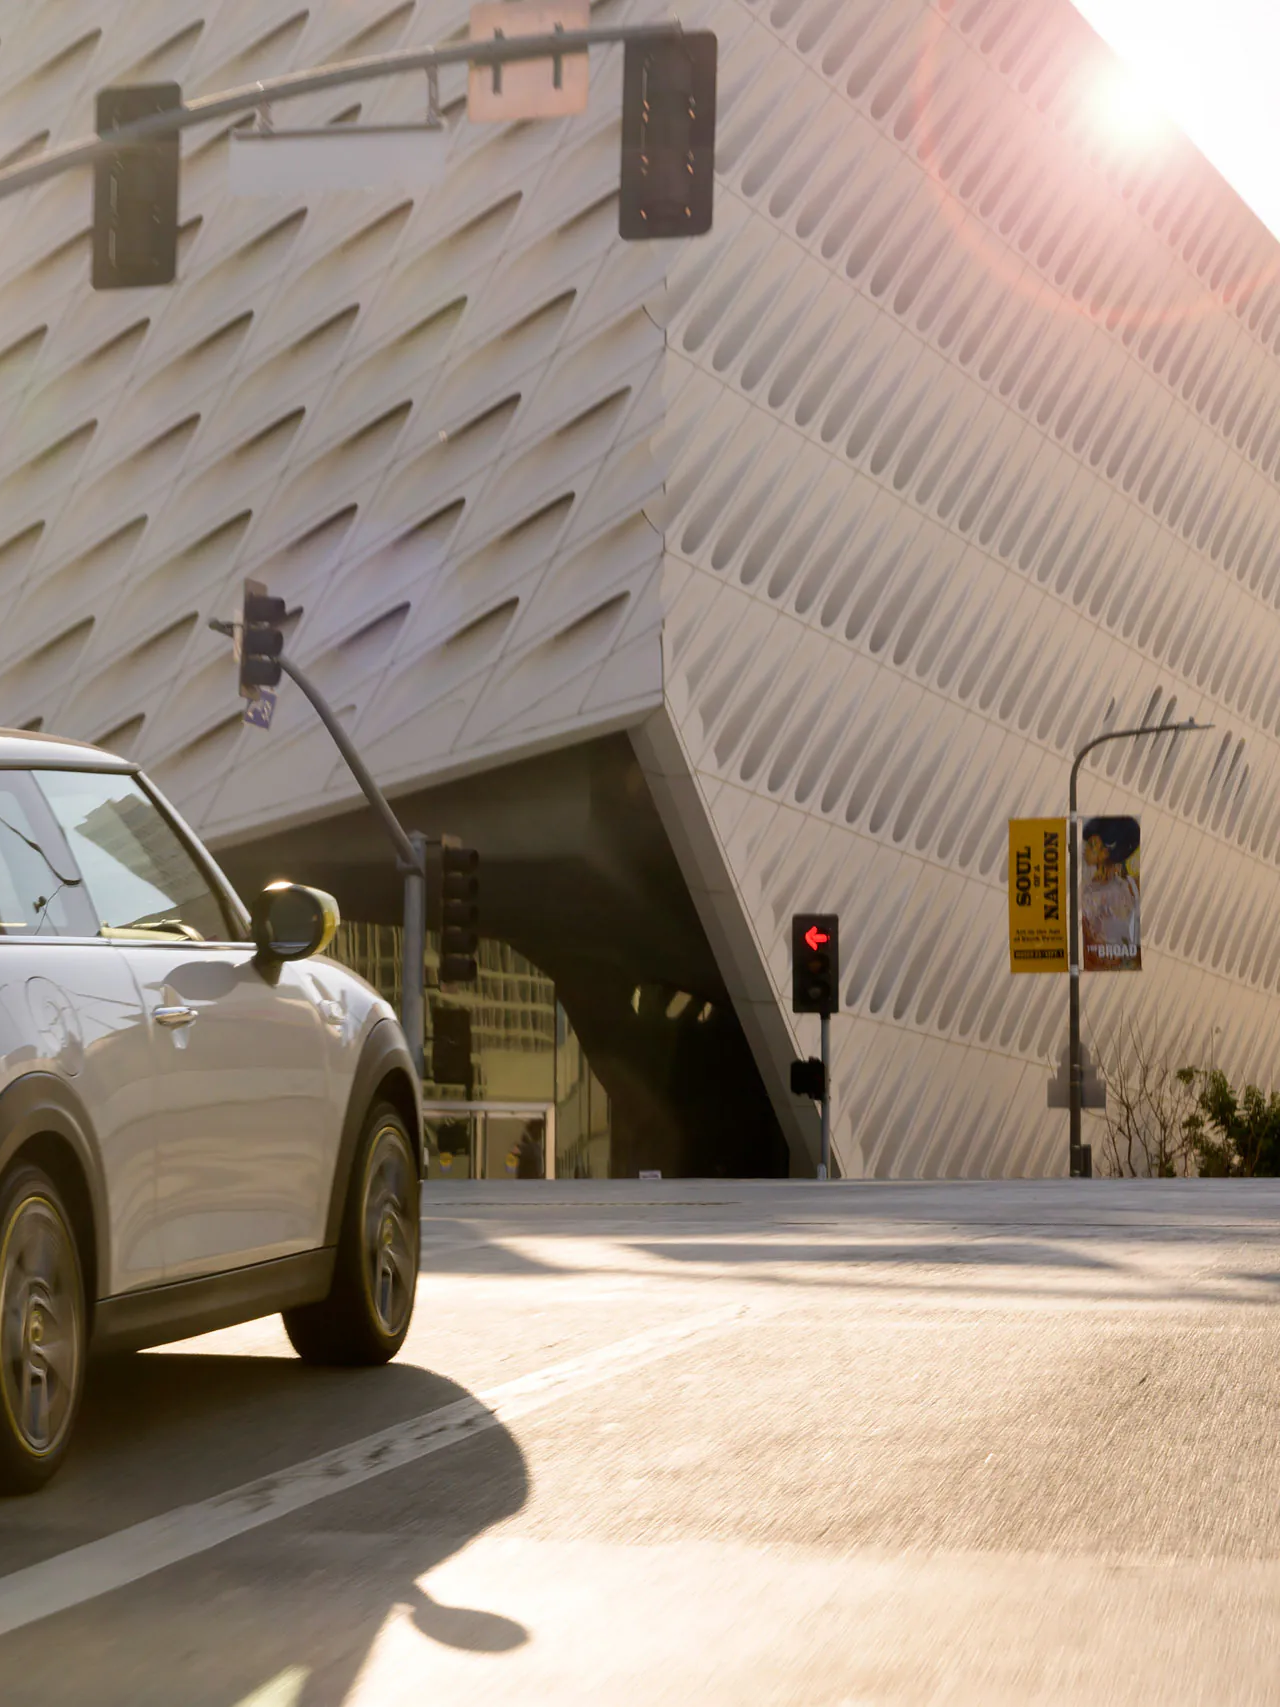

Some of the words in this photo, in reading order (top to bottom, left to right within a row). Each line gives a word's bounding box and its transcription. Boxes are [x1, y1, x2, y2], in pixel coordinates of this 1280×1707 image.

[1016, 846, 1032, 907] SOUL
[1044, 831, 1059, 920] NATION
[1098, 943, 1138, 960] BROAD
